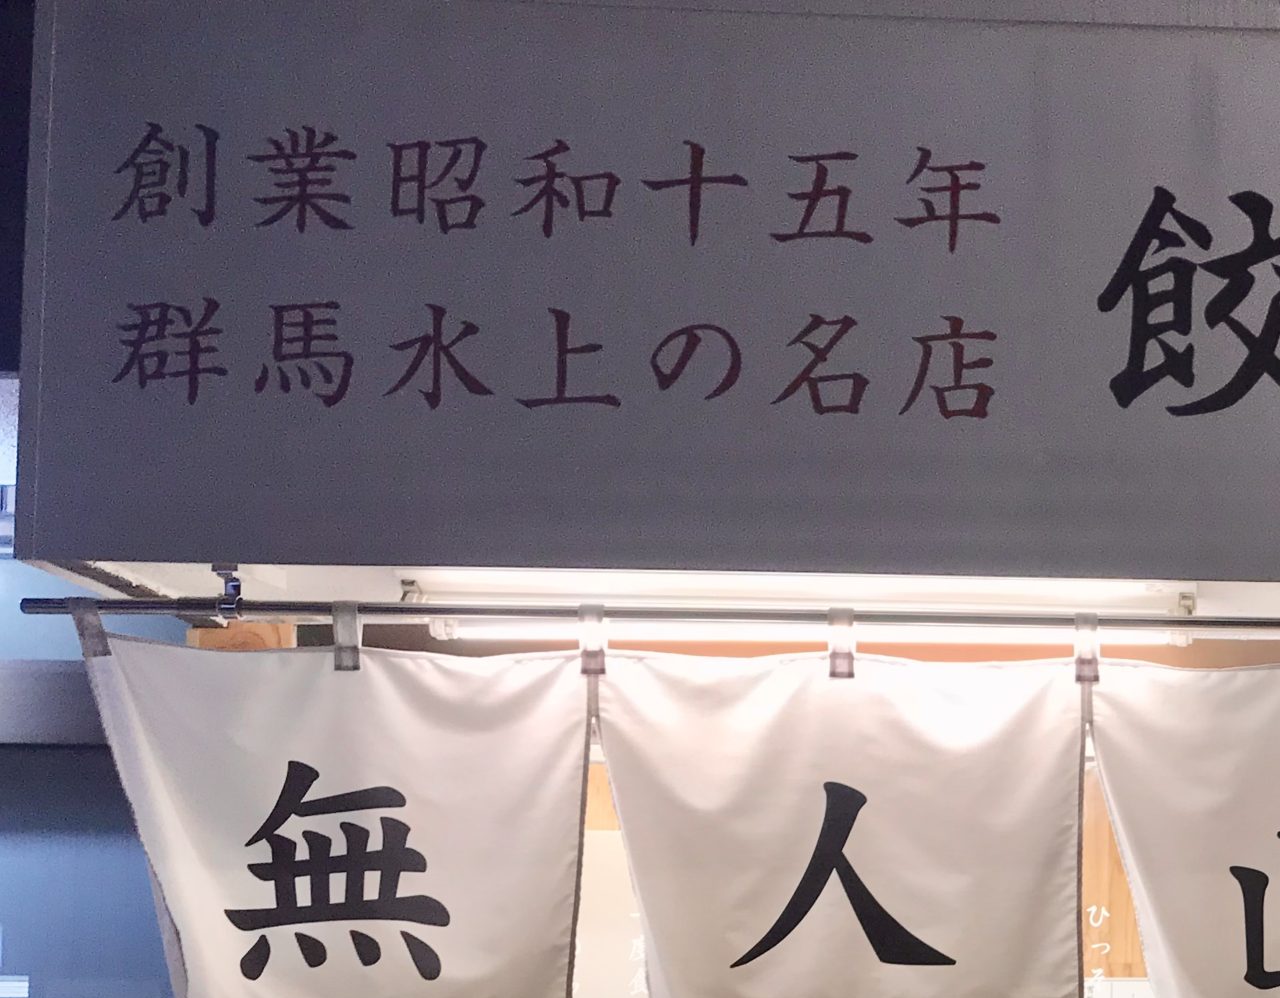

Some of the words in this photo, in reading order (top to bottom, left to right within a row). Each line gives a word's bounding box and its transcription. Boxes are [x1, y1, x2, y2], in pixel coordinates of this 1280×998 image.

[112, 122, 1001, 252] 創業昭和十五年
[110, 299, 999, 419] 群馬水上の名店
